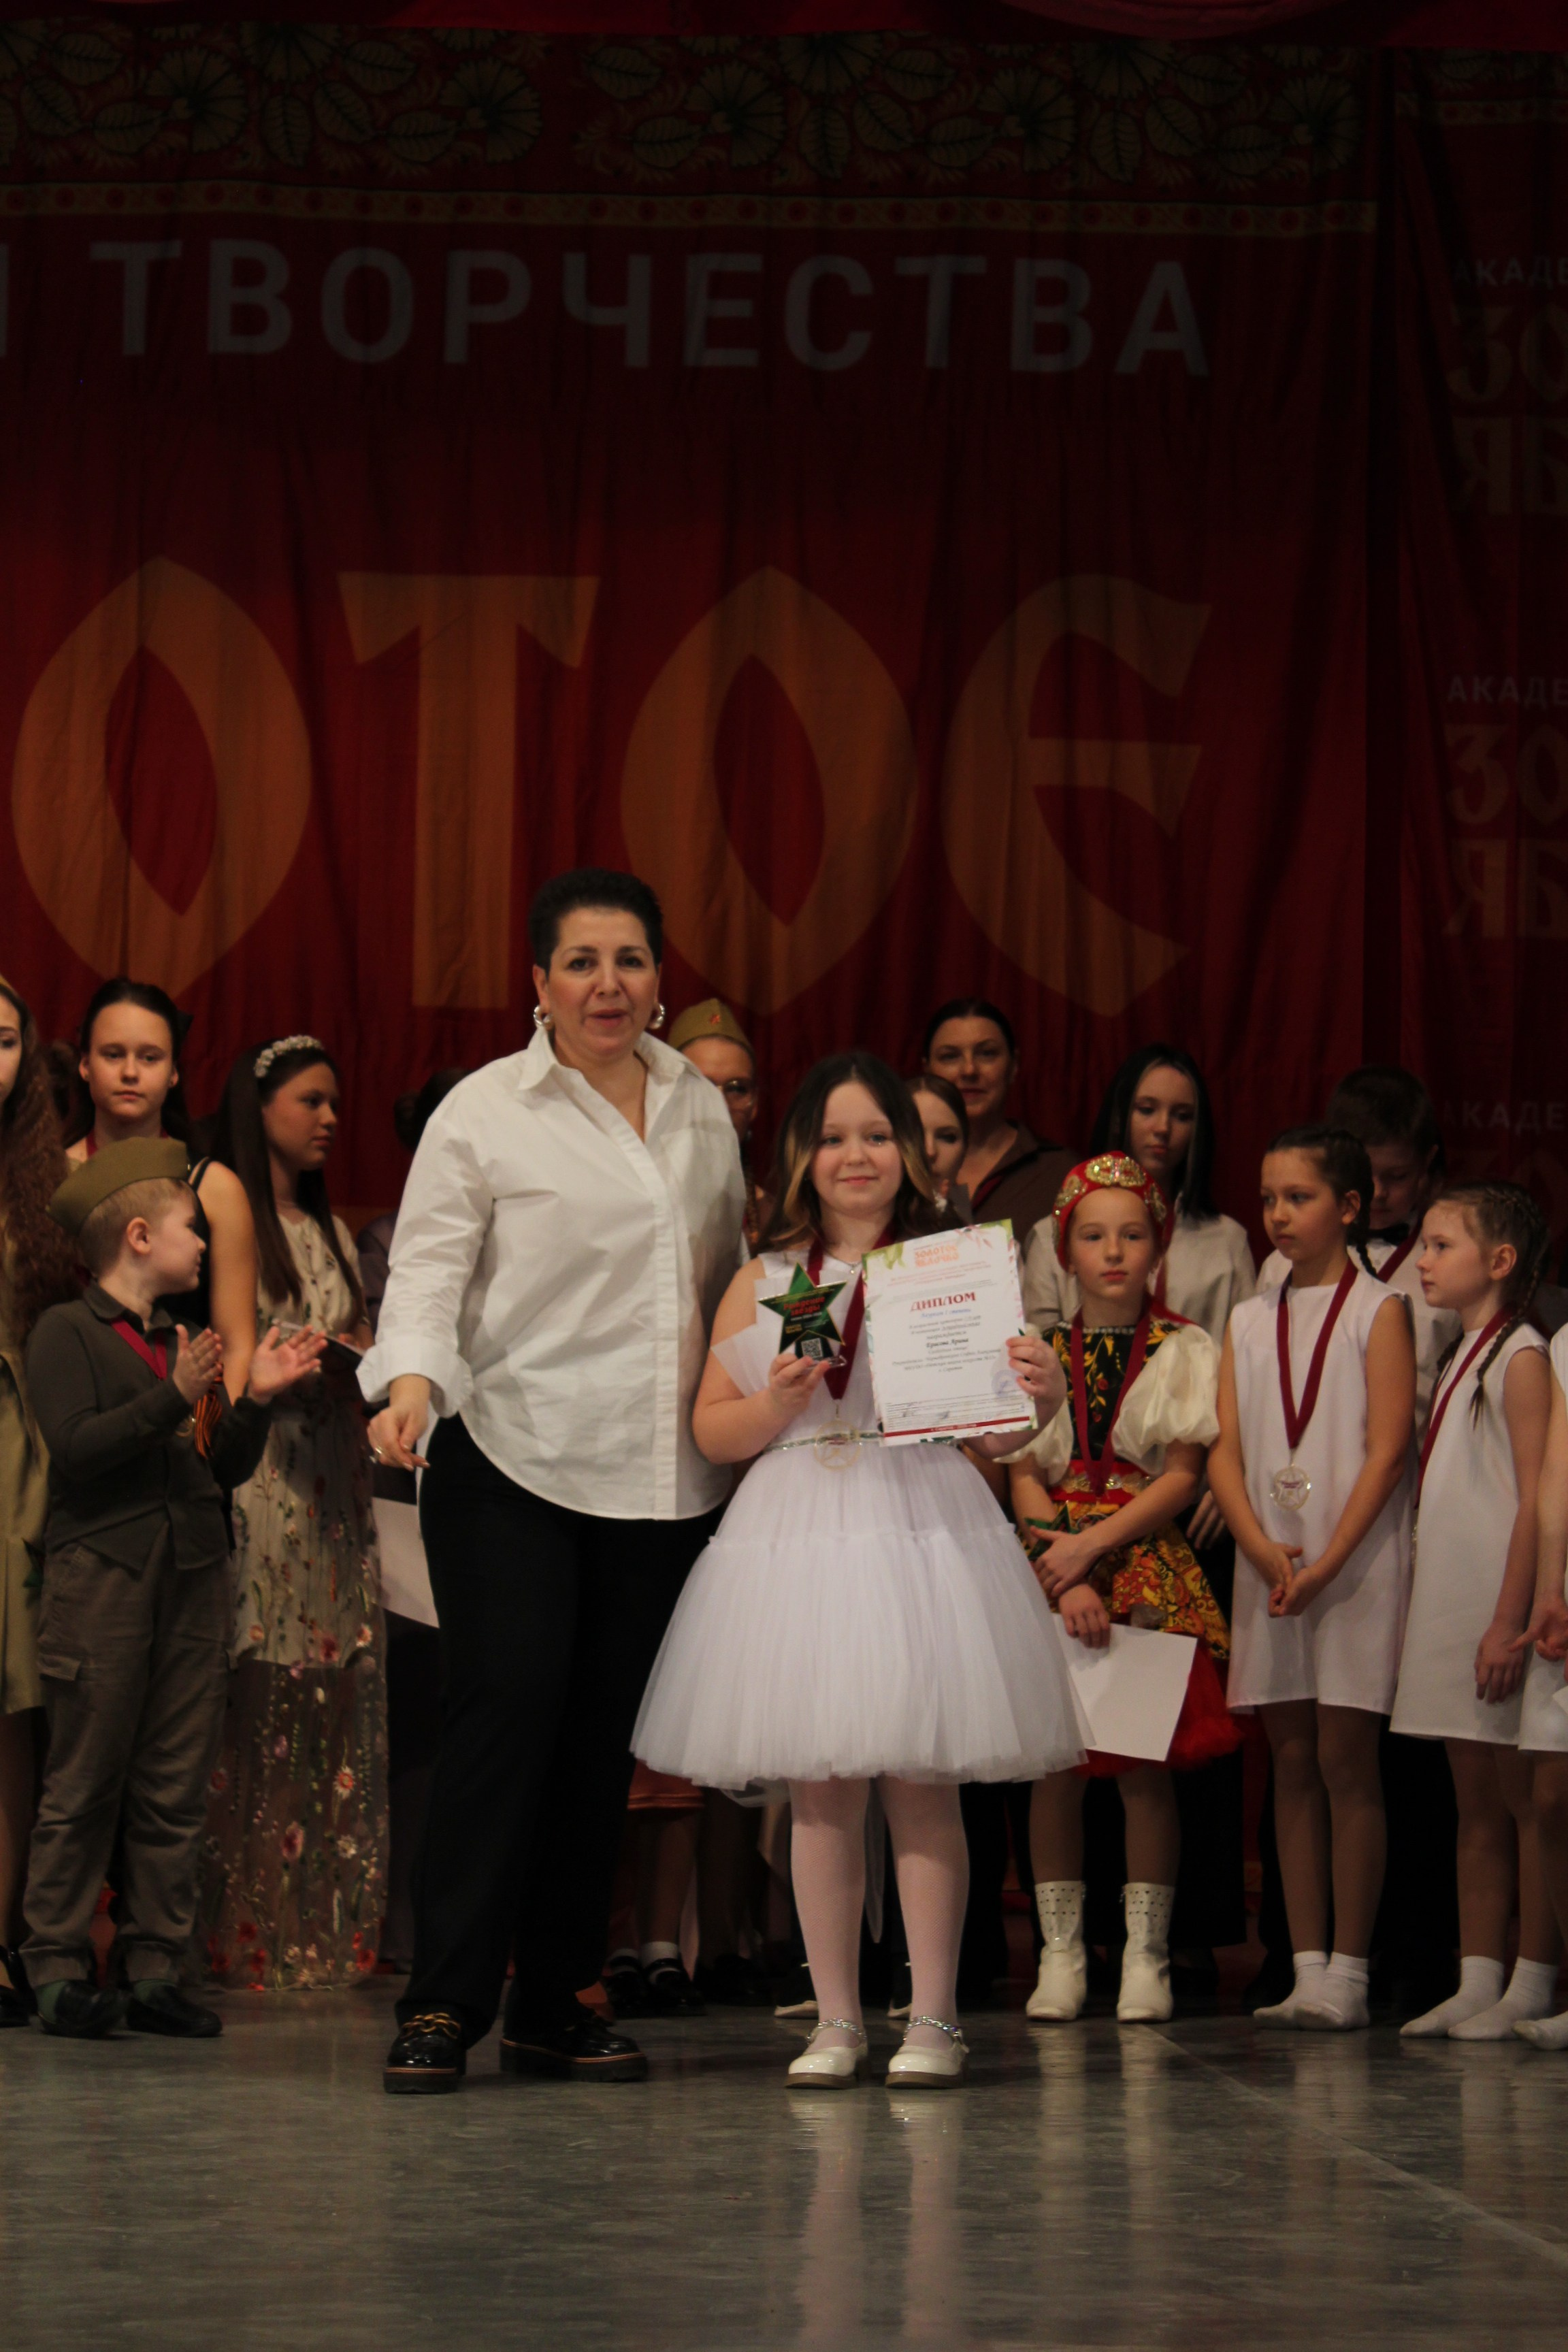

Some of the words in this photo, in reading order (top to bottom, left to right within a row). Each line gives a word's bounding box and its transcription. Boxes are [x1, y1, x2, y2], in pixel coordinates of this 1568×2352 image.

[90, 238, 1210, 378] ТВОРЧЕСТВА
[1448, 675, 1568, 710] АКАДЕ
[910, 1292, 976, 1312] ДИПЛОМ
